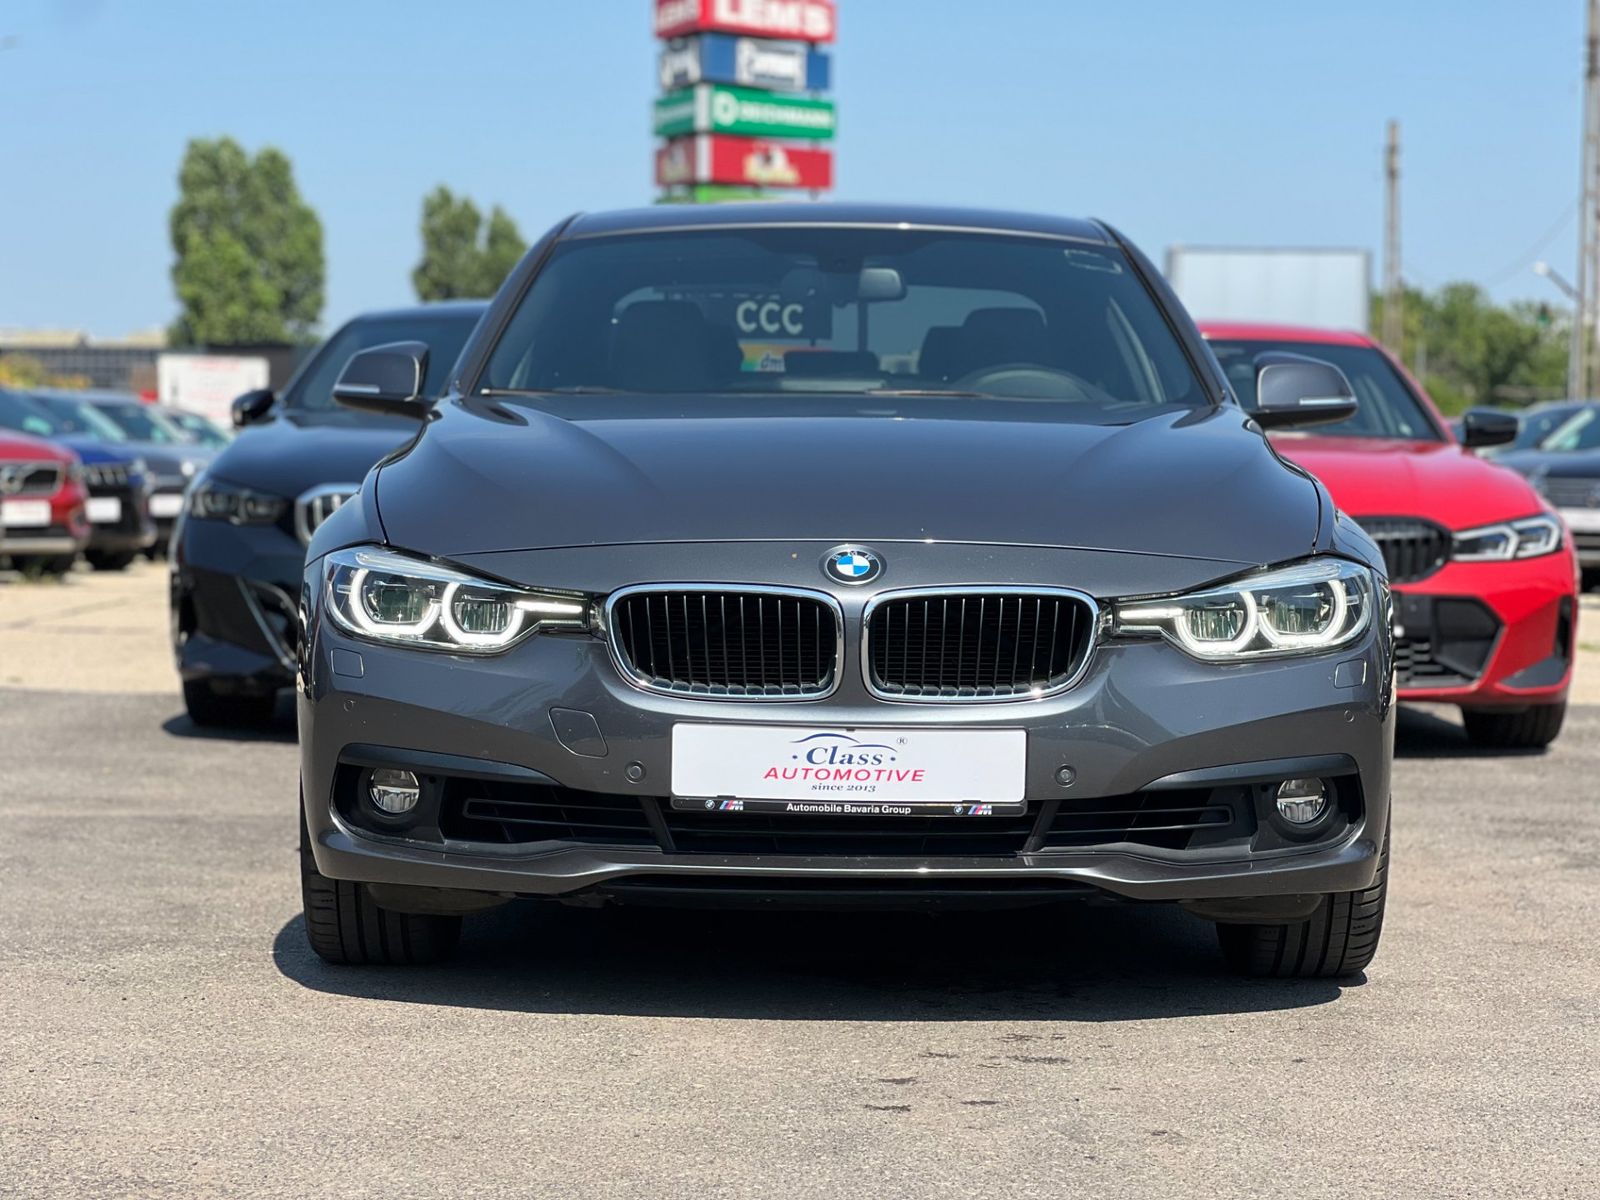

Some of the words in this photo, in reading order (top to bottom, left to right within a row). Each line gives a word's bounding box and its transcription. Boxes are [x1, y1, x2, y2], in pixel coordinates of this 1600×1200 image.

[736, 300, 804, 335] CCC
[806, 746, 883, 765] Class
[763, 767, 926, 782] AUTOMOTIVE
[811, 782, 844, 792] since
[846, 785, 876, 793] 2013
[786, 803, 841, 812] Automobile
[844, 805, 880, 813] Bavaria
[881, 805, 912, 814] Group
